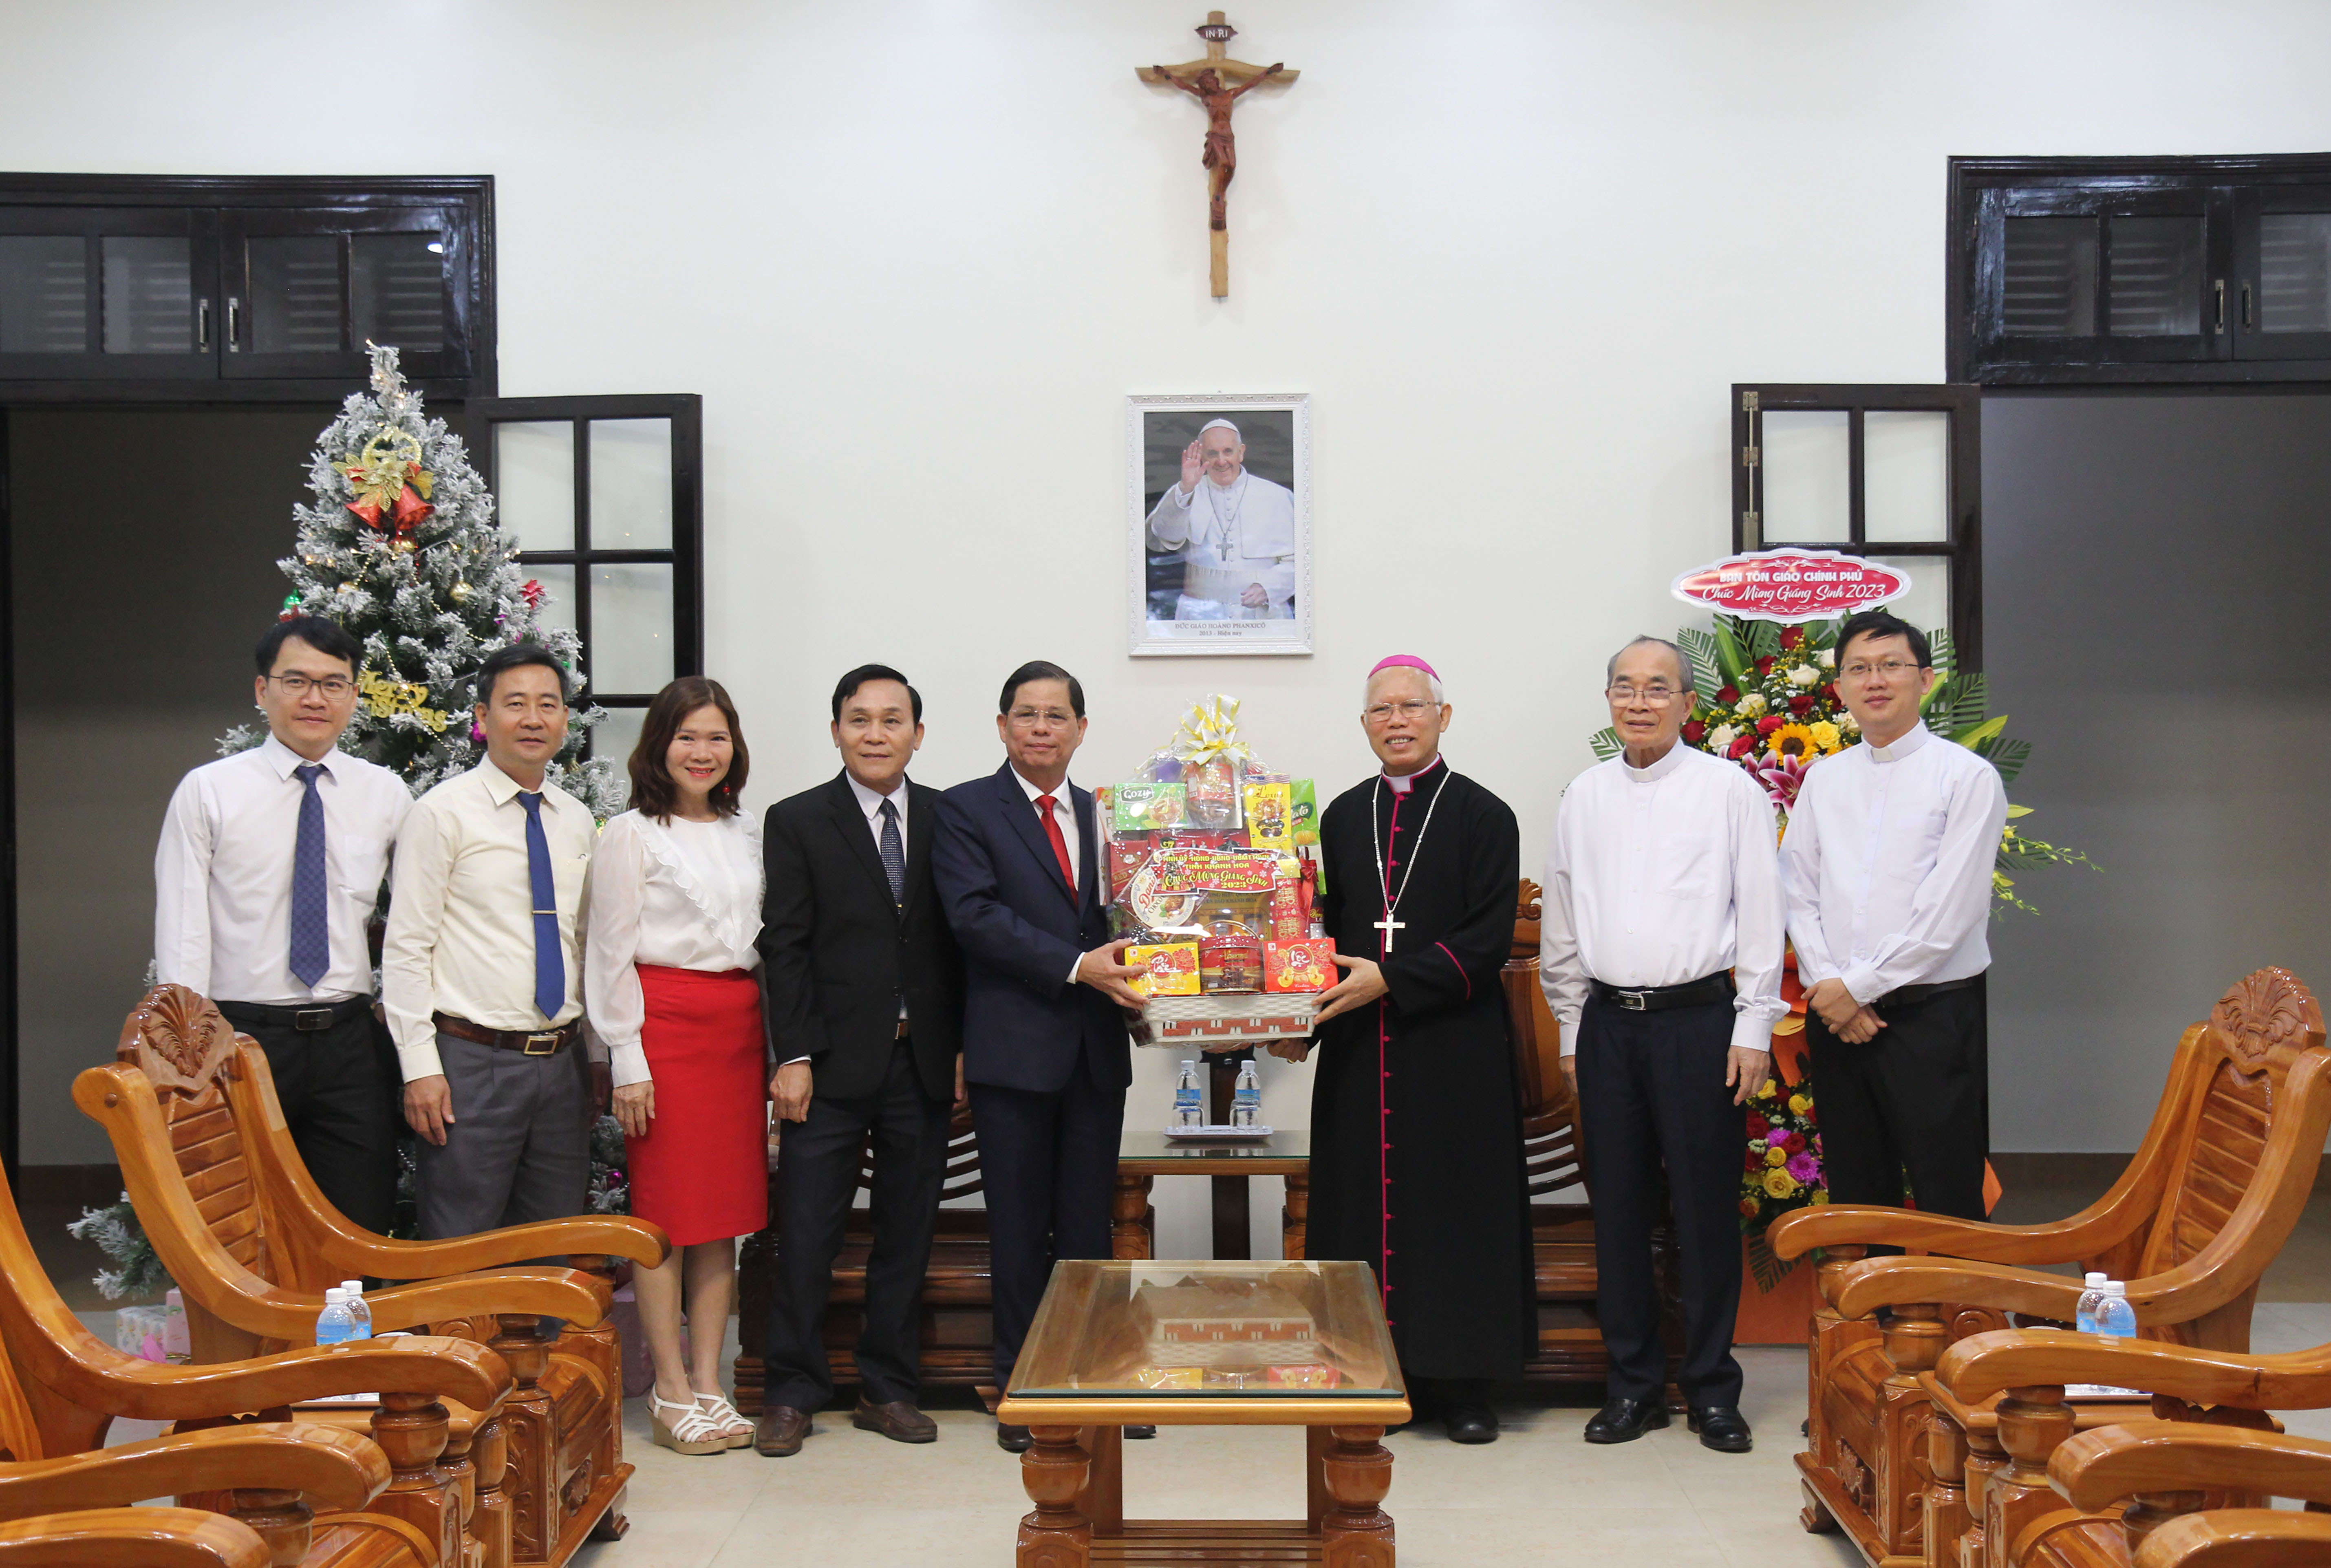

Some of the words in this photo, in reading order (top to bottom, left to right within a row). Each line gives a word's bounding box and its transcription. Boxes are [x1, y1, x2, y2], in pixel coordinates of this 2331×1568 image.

[1719, 573, 1742, 582] BAN
[1745, 571, 1770, 582] TÔN
[1772, 571, 1801, 582] GIÁO
[1803, 570, 1837, 582] CHÍNH
[1839, 569, 1863, 581] PHỦ
[1702, 586, 1734, 601] Chúc
[1777, 585, 1811, 603] Giáng
[1814, 585, 1844, 601] Sinh
[1845, 584, 1886, 598] 2023
[1290, 950, 1310, 967] Lộc
